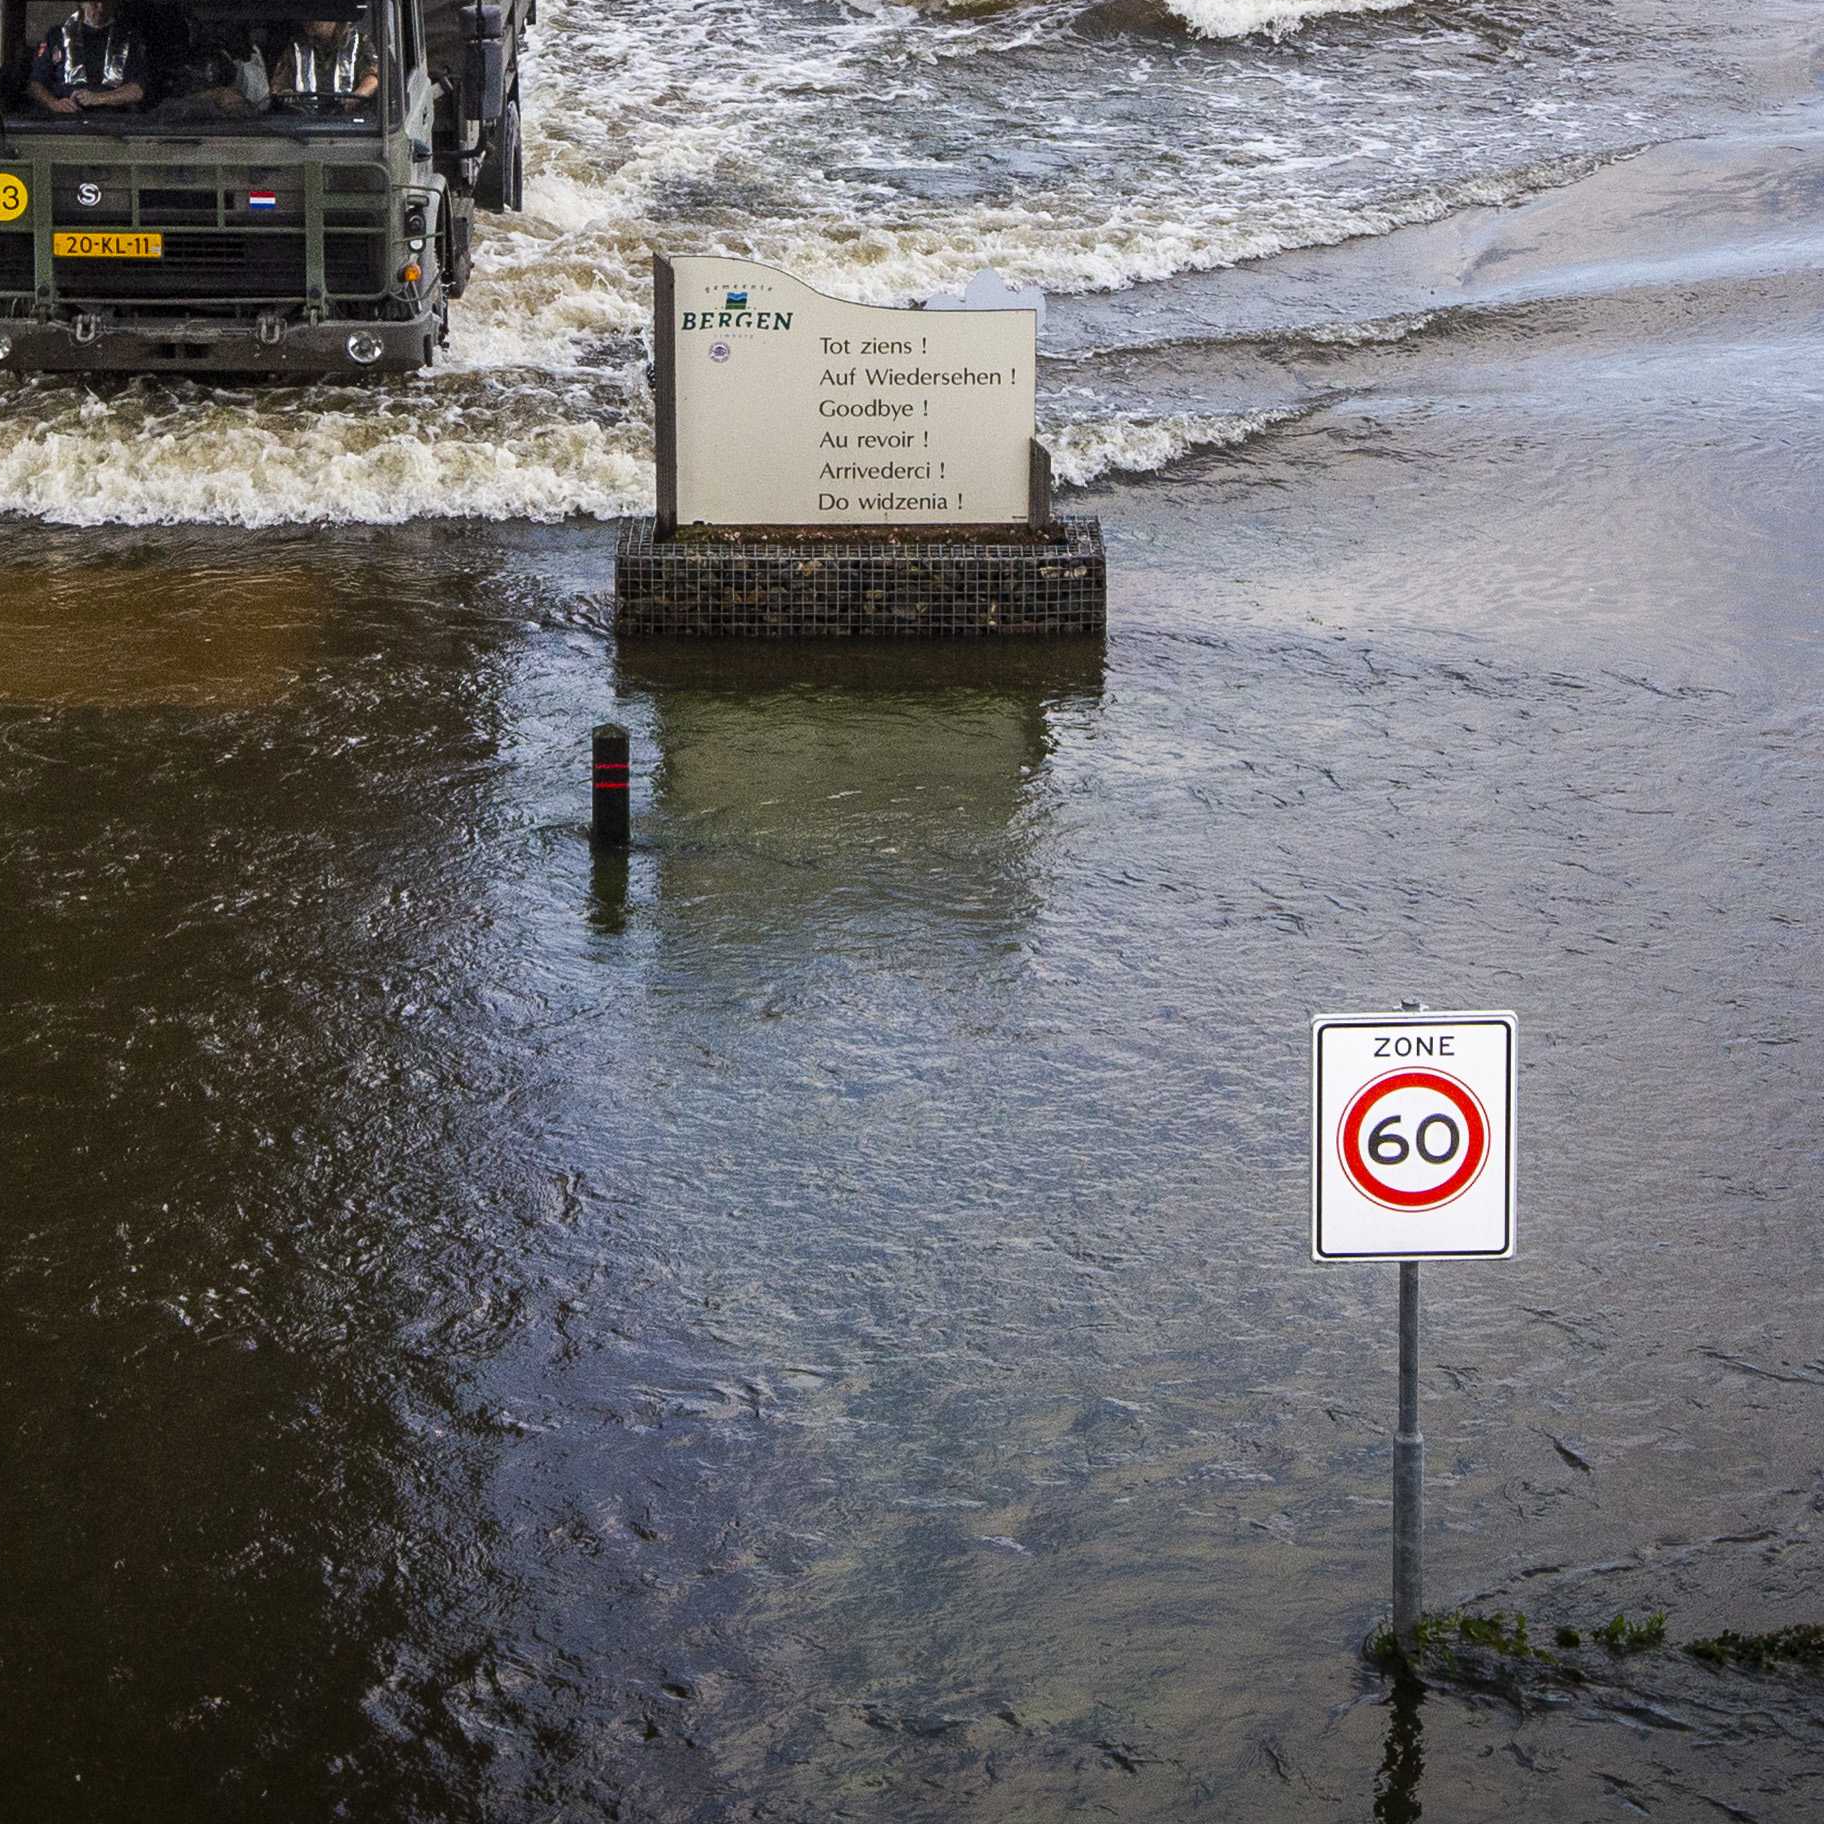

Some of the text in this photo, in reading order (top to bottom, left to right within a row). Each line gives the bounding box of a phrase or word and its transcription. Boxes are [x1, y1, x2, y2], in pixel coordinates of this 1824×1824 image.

[66, 236, 149, 255] 20-KL-11
[681, 311, 794, 331] BERGEN
[819, 337, 927, 355] Tot ziens !
[819, 367, 1016, 386] Auf Wiedersehen !
[818, 398, 928, 422] Goodbye !
[819, 431, 929, 449] Au revoir !
[819, 461, 945, 480] Arrivederci !
[818, 492, 963, 511] Do widzenia !
[1373, 1035, 1455, 1058] ZONE
[1368, 1112, 1460, 1166] 60
